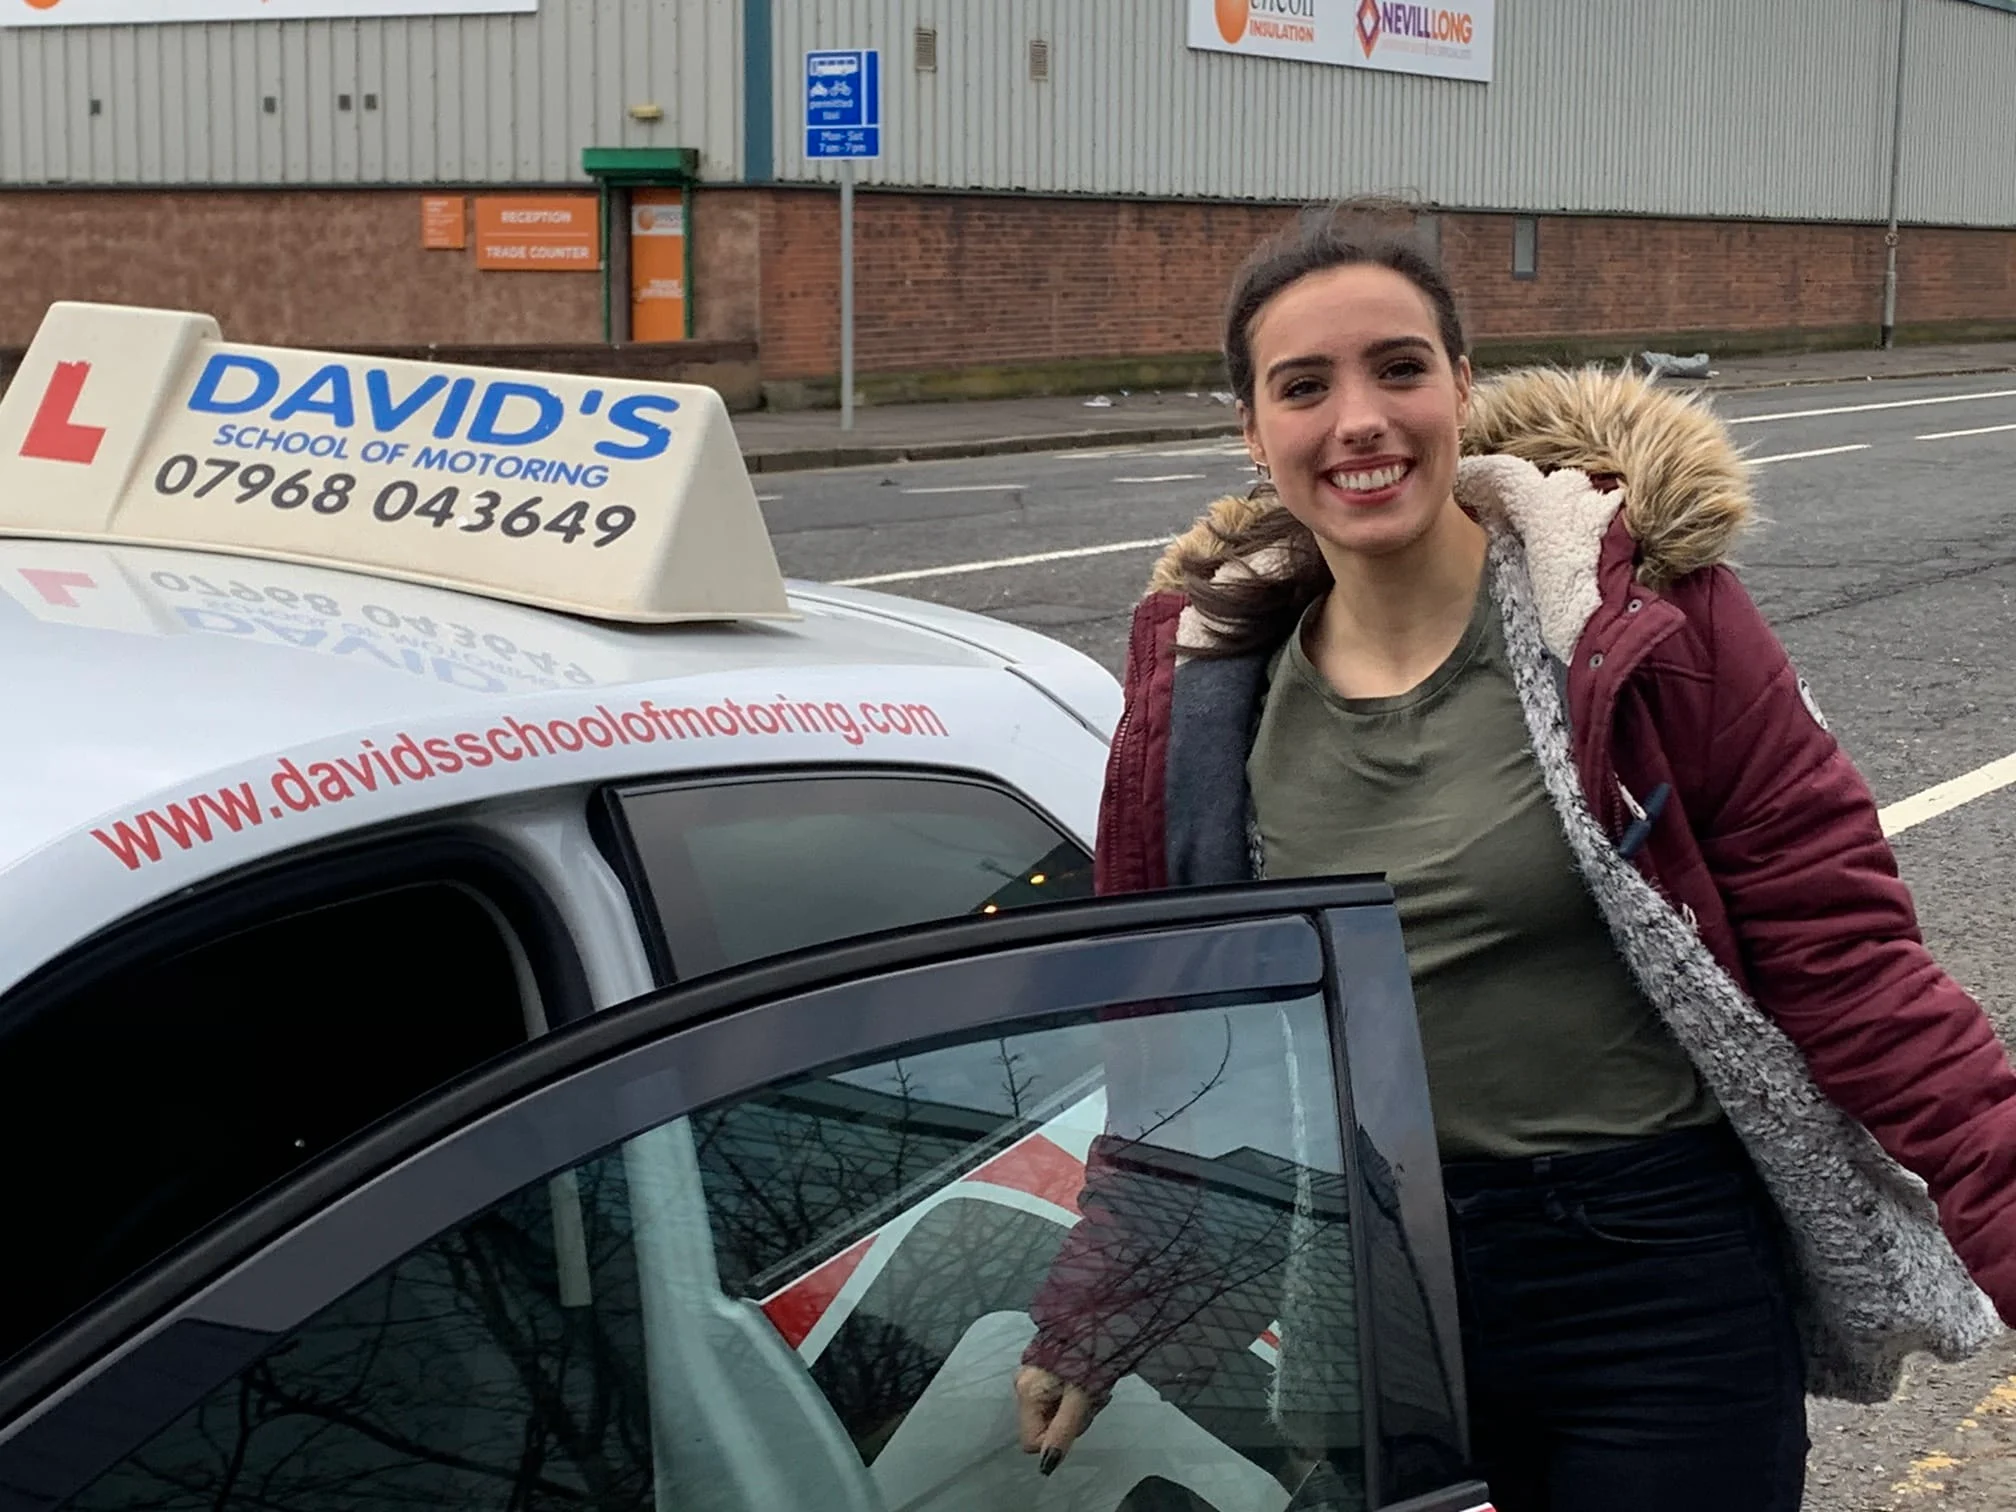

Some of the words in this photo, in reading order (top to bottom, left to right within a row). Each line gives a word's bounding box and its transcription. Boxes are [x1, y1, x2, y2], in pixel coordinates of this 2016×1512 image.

[1249, 19, 1314, 42] INSULATION
[486, 245, 527, 259] TRADE
[529, 246, 590, 260] COUNTER
[501, 210, 572, 223] RECEPTION
[19, 360, 106, 465] L
[188, 353, 680, 461] DAVID'S
[213, 424, 349, 459] SCHOOL
[360, 440, 409, 466] OF
[412, 446, 609, 489] MOTORING
[154, 454, 357, 515] 07968
[372, 480, 637, 548] 043649
[89, 693, 950, 871] www.davidsschoolofmotoring.com
